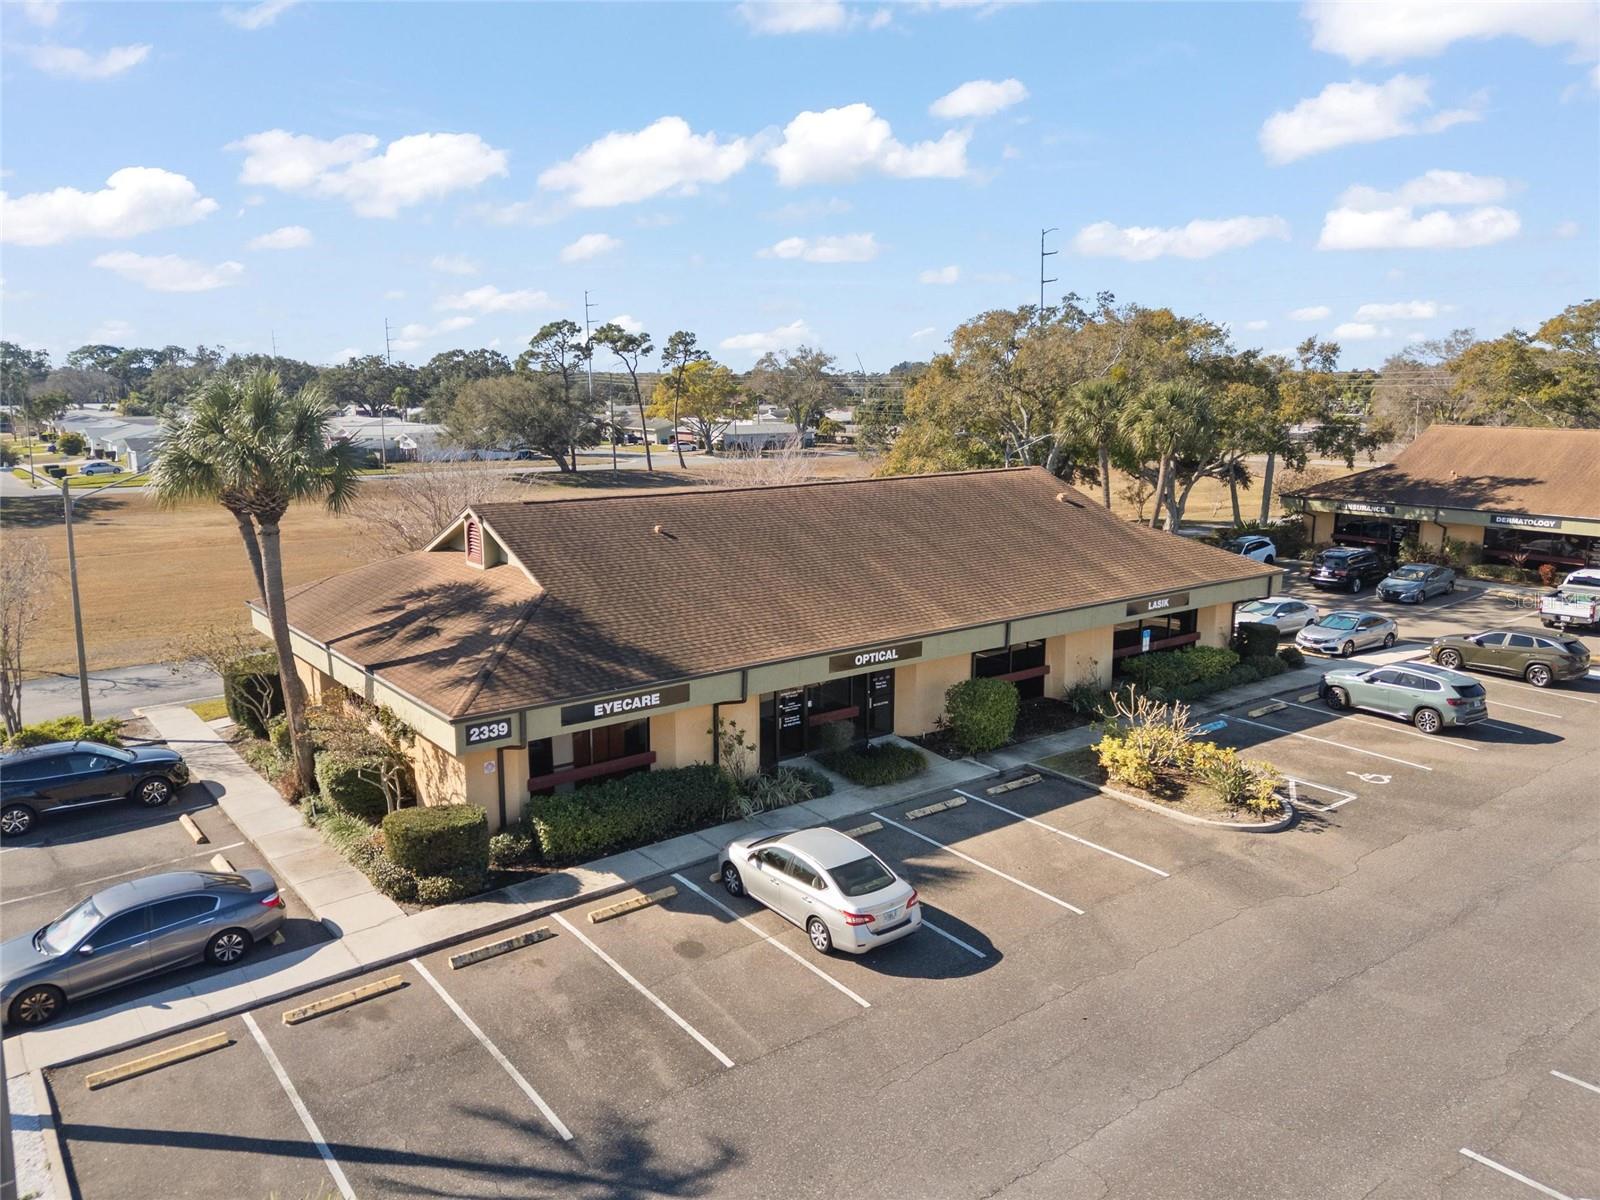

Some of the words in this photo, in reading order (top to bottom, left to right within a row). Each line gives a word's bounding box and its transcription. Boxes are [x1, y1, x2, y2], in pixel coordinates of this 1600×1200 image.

[1345, 503, 1386, 513] INSURANCE
[1495, 516, 1555, 528] DERMATOLOGY
[1148, 598, 1170, 610] LASIK
[854, 649, 898, 666] OPTICAL
[594, 693, 660, 716] EYECARE
[470, 722, 509, 742] 2339
